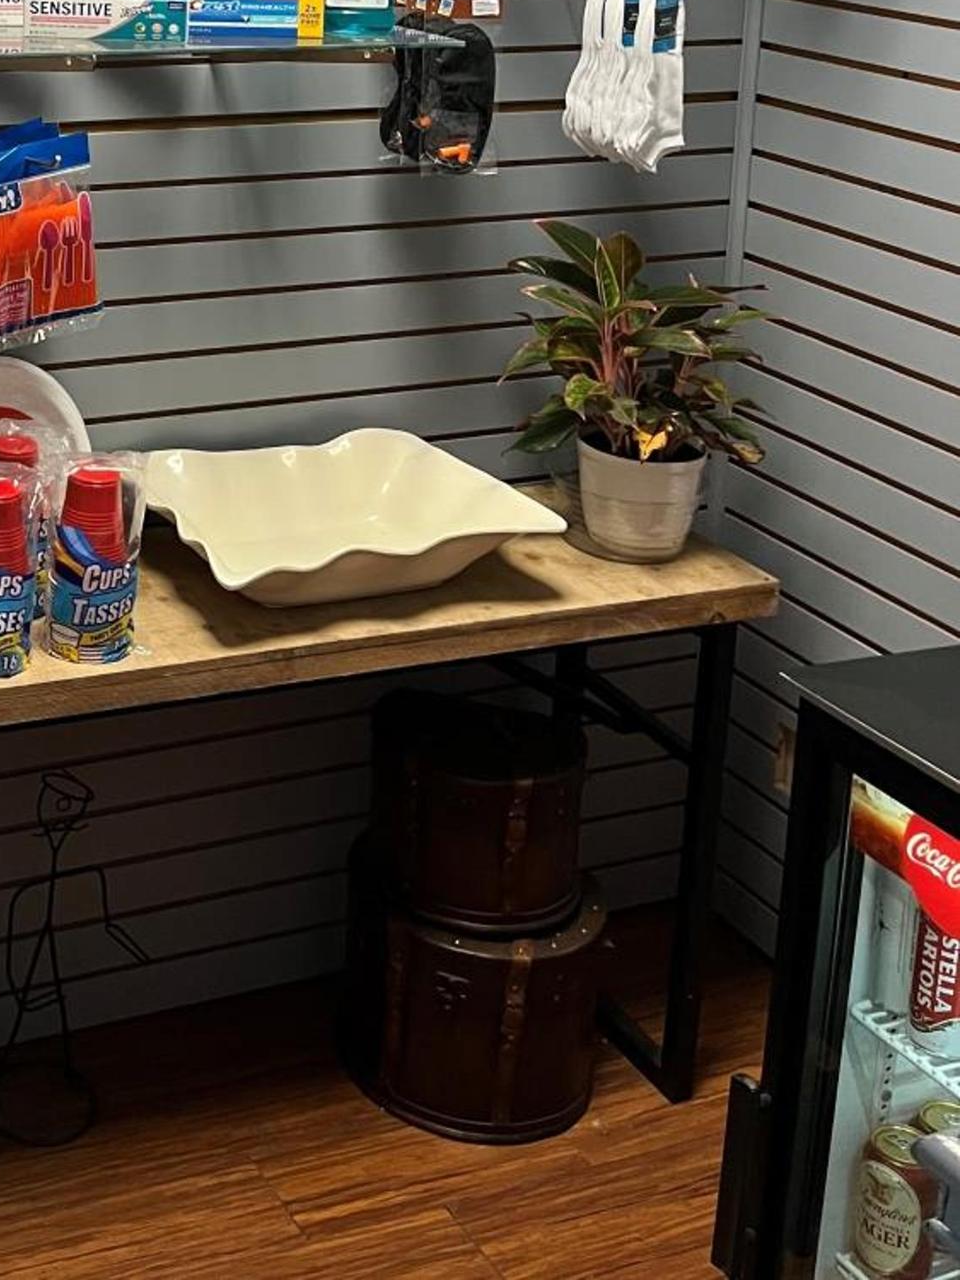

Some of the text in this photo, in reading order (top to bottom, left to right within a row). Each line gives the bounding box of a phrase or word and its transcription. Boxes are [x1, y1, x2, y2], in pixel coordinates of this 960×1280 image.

[29, 0, 113, 18] SENSITIVE
[81, 564, 130, 593] CUPS
[72, 594, 133, 626] TASSES
[916, 926, 940, 1010] ARTOIS
[933, 936, 960, 1014] STELLA
